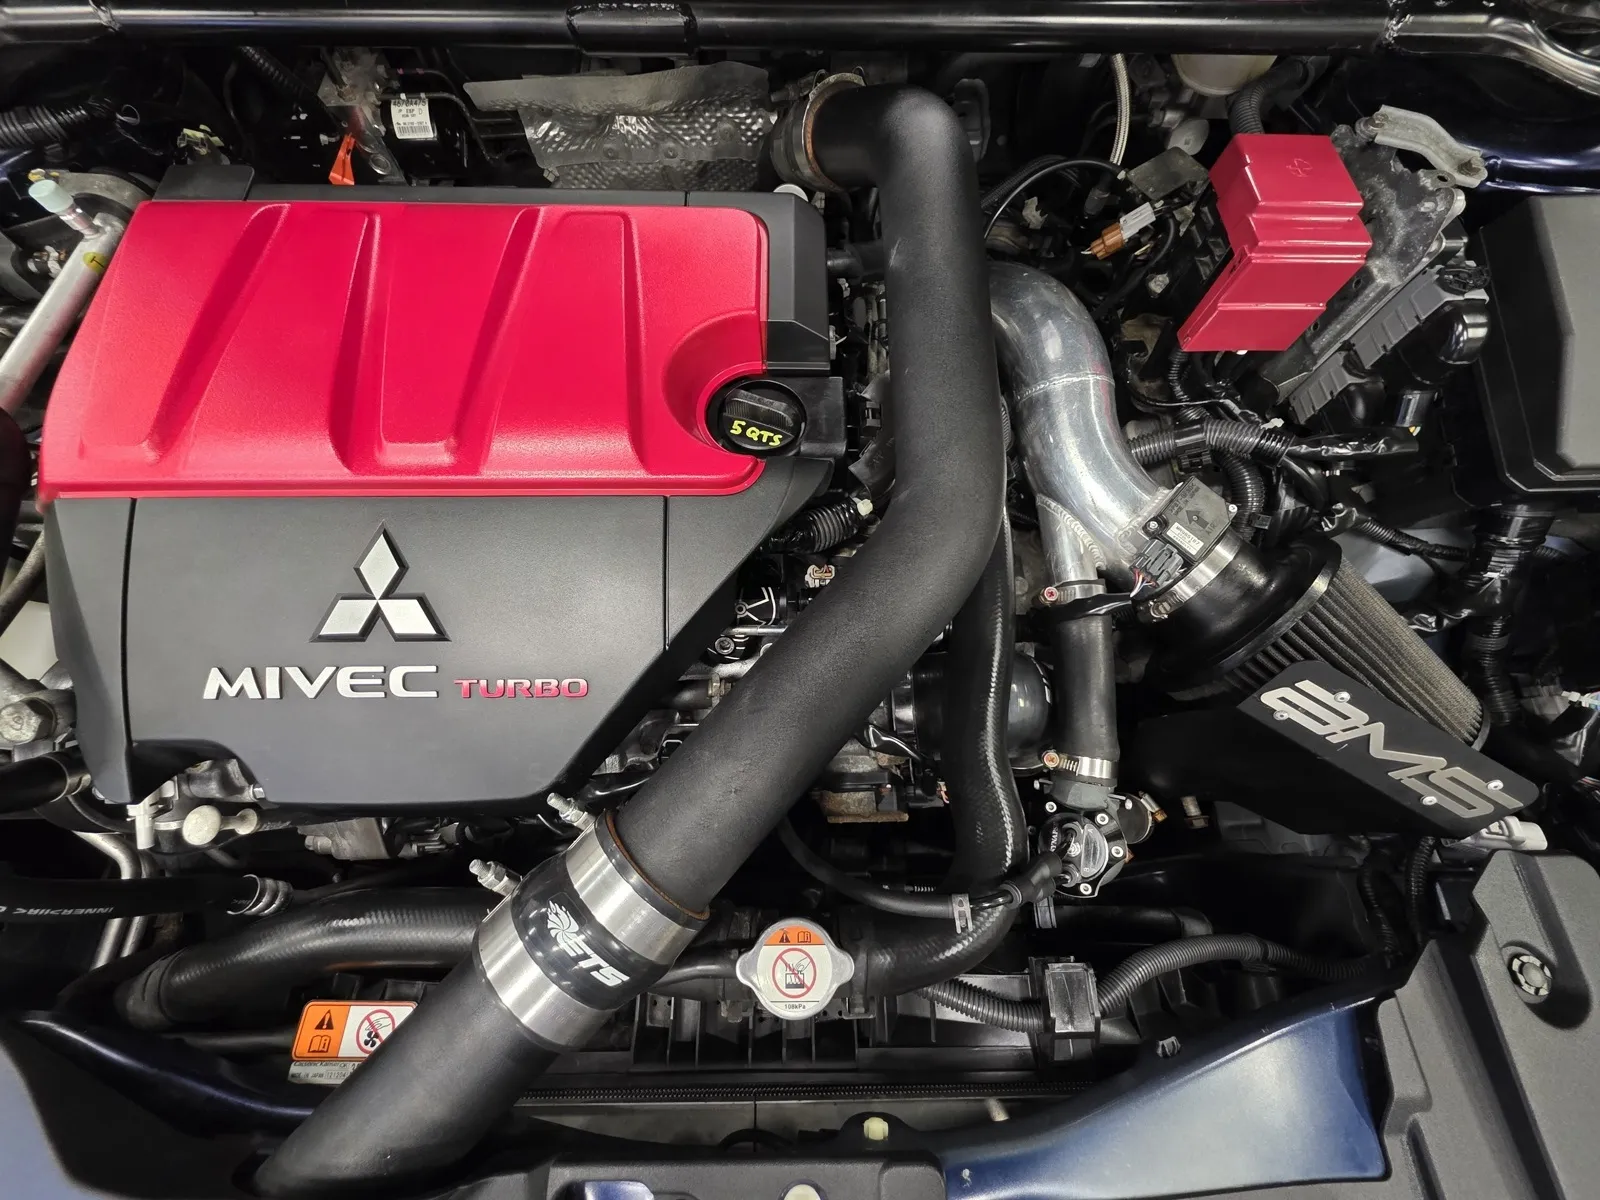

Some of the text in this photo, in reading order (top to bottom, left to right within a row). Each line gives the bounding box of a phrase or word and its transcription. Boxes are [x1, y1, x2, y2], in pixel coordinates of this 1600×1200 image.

[730, 420, 783, 446] 5 QTS
[1204, 522, 1217, 536] AIR
[203, 666, 590, 699] MIVEC TURBO
[558, 936, 631, 987] ETS
